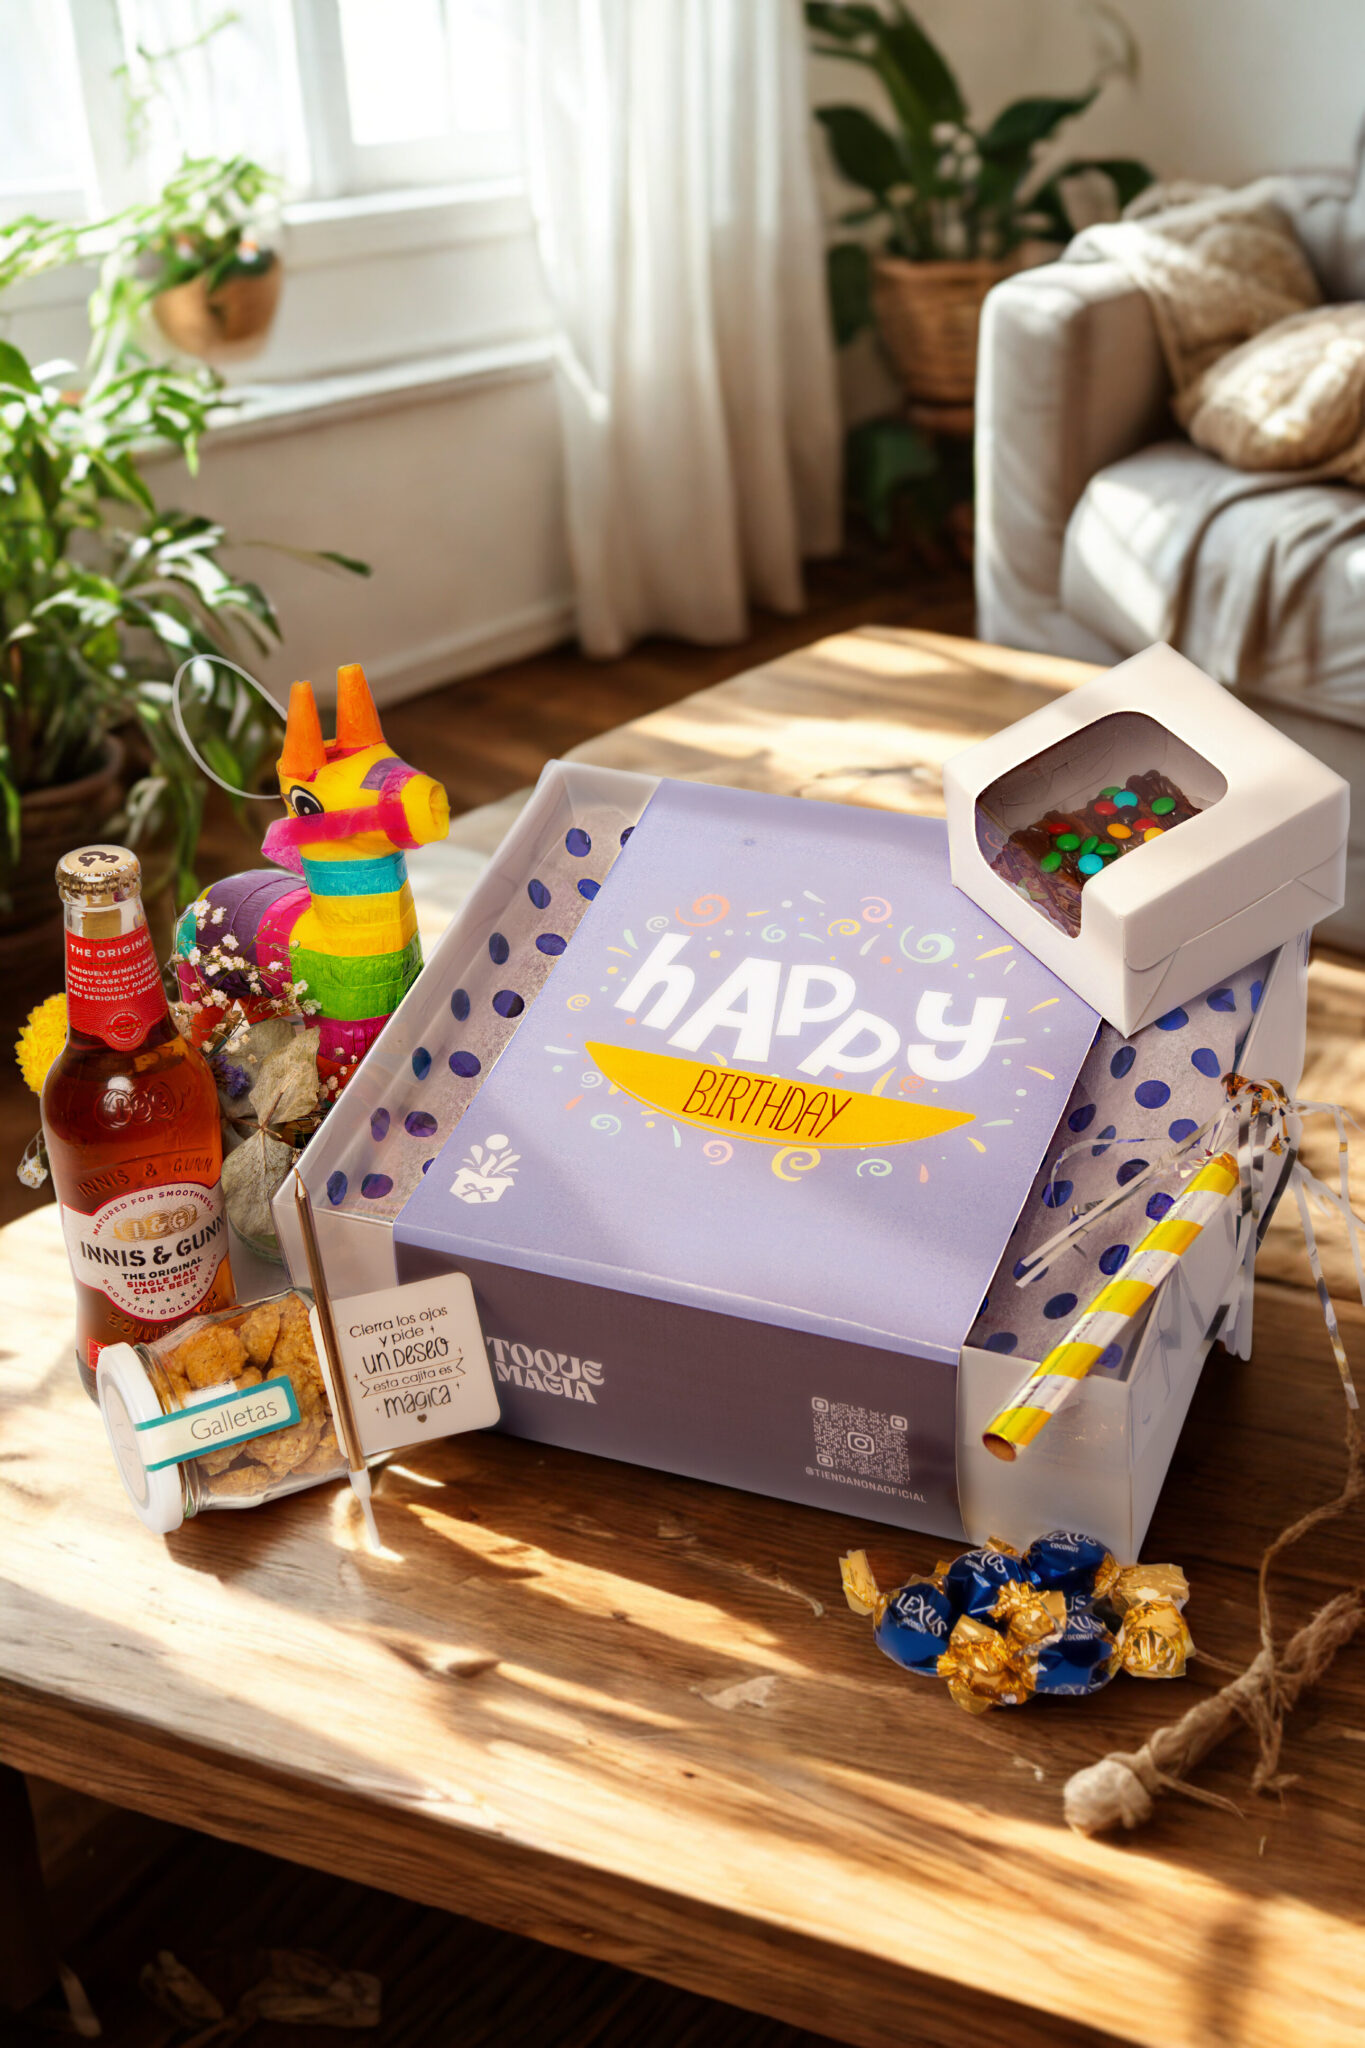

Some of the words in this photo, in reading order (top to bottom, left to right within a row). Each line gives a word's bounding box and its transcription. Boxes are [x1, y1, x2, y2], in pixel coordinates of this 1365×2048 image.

[70, 943, 92, 958] THE
[71, 964, 110, 977] UNIQUELY
[112, 962, 142, 976] SINGLE
[95, 977, 120, 985] CASK
[74, 981, 130, 993] DELICIOUSLY
[84, 991, 135, 1002] SERIOUSLY
[682, 1069, 853, 1139] BIRTHDAY
[78, 1168, 131, 1199] INNIS
[145, 1162, 158, 1177] &
[92, 1202, 128, 1236] MATURED
[130, 1194, 154, 1206] FOR
[158, 1189, 214, 1212] SMOOTHNESS
[80, 1240, 147, 1267] INNIS
[152, 1245, 172, 1266] &
[176, 1207, 226, 1257] GUNN
[121, 1272, 146, 1281] THE
[148, 1256, 204, 1279] ORIGINAL
[126, 1275, 170, 1289] SINGLE
[173, 1264, 201, 1281] MALT
[102, 1278, 155, 1316] SCOTTISH
[159, 1287, 204, 1315] GOLDEN
[133, 1285, 166, 1295] CASK
[168, 1274, 197, 1291] BEER
[349, 1320, 394, 1338] Cierra
[396, 1314, 416, 1327] los
[419, 1306, 448, 1322] ojos
[378, 1335, 388, 1348] y
[391, 1326, 425, 1345] pide
[362, 1351, 391, 1375] un
[486, 1336, 605, 1386] TOQUE
[373, 1378, 399, 1392] esta
[401, 1369, 436, 1385] cajita
[438, 1365, 453, 1376] es
[494, 1360, 598, 1405] MAGIA
[383, 1384, 452, 1419] mágica
[190, 1400, 279, 1440] Galletas
[1049, 1542, 1080, 1553] COCONUT
[896, 1592, 948, 1638] LEXUS
[1063, 1632, 1094, 1641] COCONUT
